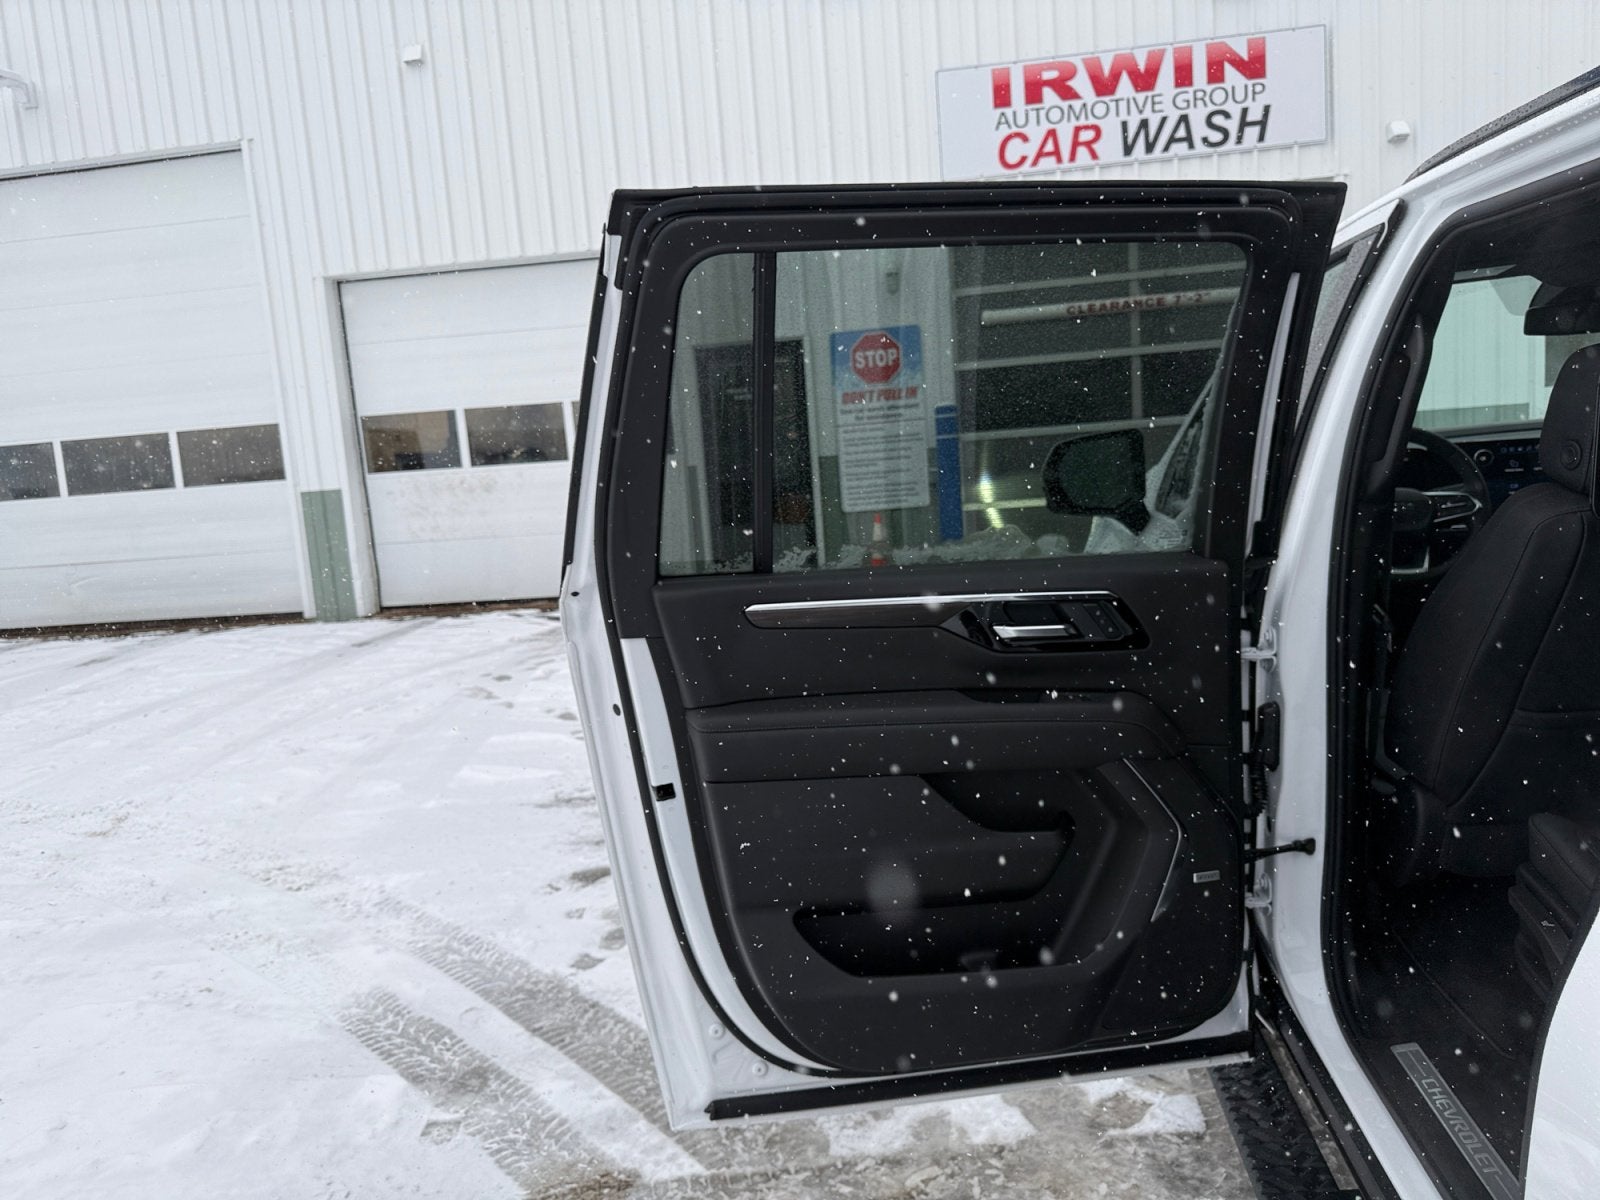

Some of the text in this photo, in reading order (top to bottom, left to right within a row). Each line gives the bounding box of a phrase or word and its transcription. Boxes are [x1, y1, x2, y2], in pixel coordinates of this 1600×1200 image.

[991, 36, 1267, 109] IRWIN
[994, 82, 1266, 131] AUTOMOTIVE GROUP
[998, 104, 1271, 171] CAR WASH
[1066, 296, 1166, 316] CLEARANCE
[854, 348, 898, 369] STOP
[1421, 1077, 1503, 1176] CHEVROLET
